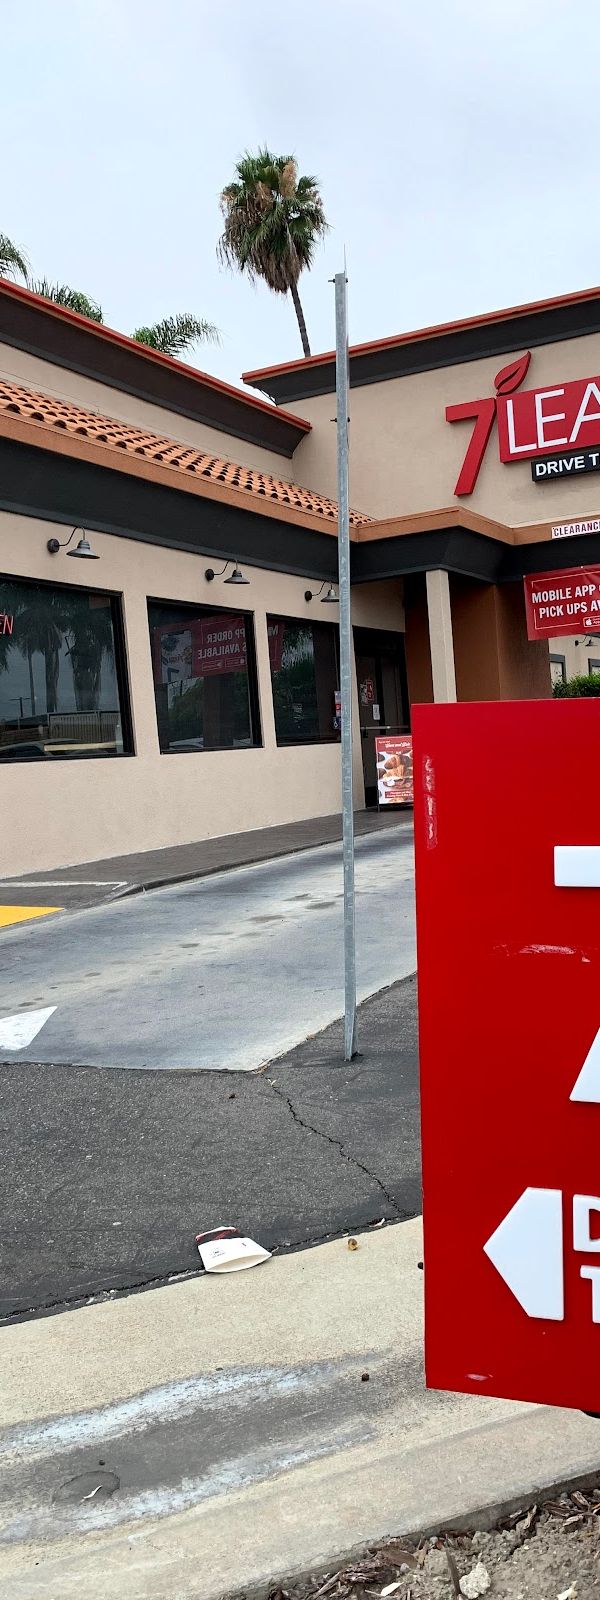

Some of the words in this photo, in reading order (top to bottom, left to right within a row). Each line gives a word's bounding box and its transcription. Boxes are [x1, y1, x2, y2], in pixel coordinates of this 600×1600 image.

[445, 397, 498, 498] 7
[535, 455, 586, 477] DRIVE
[553, 521, 600, 537] CLEARANC
[531, 587, 573, 604] MOBILE
[575, 585, 596, 598] APP
[539, 604, 564, 619] PICK
[566, 601, 588, 616] UPS
